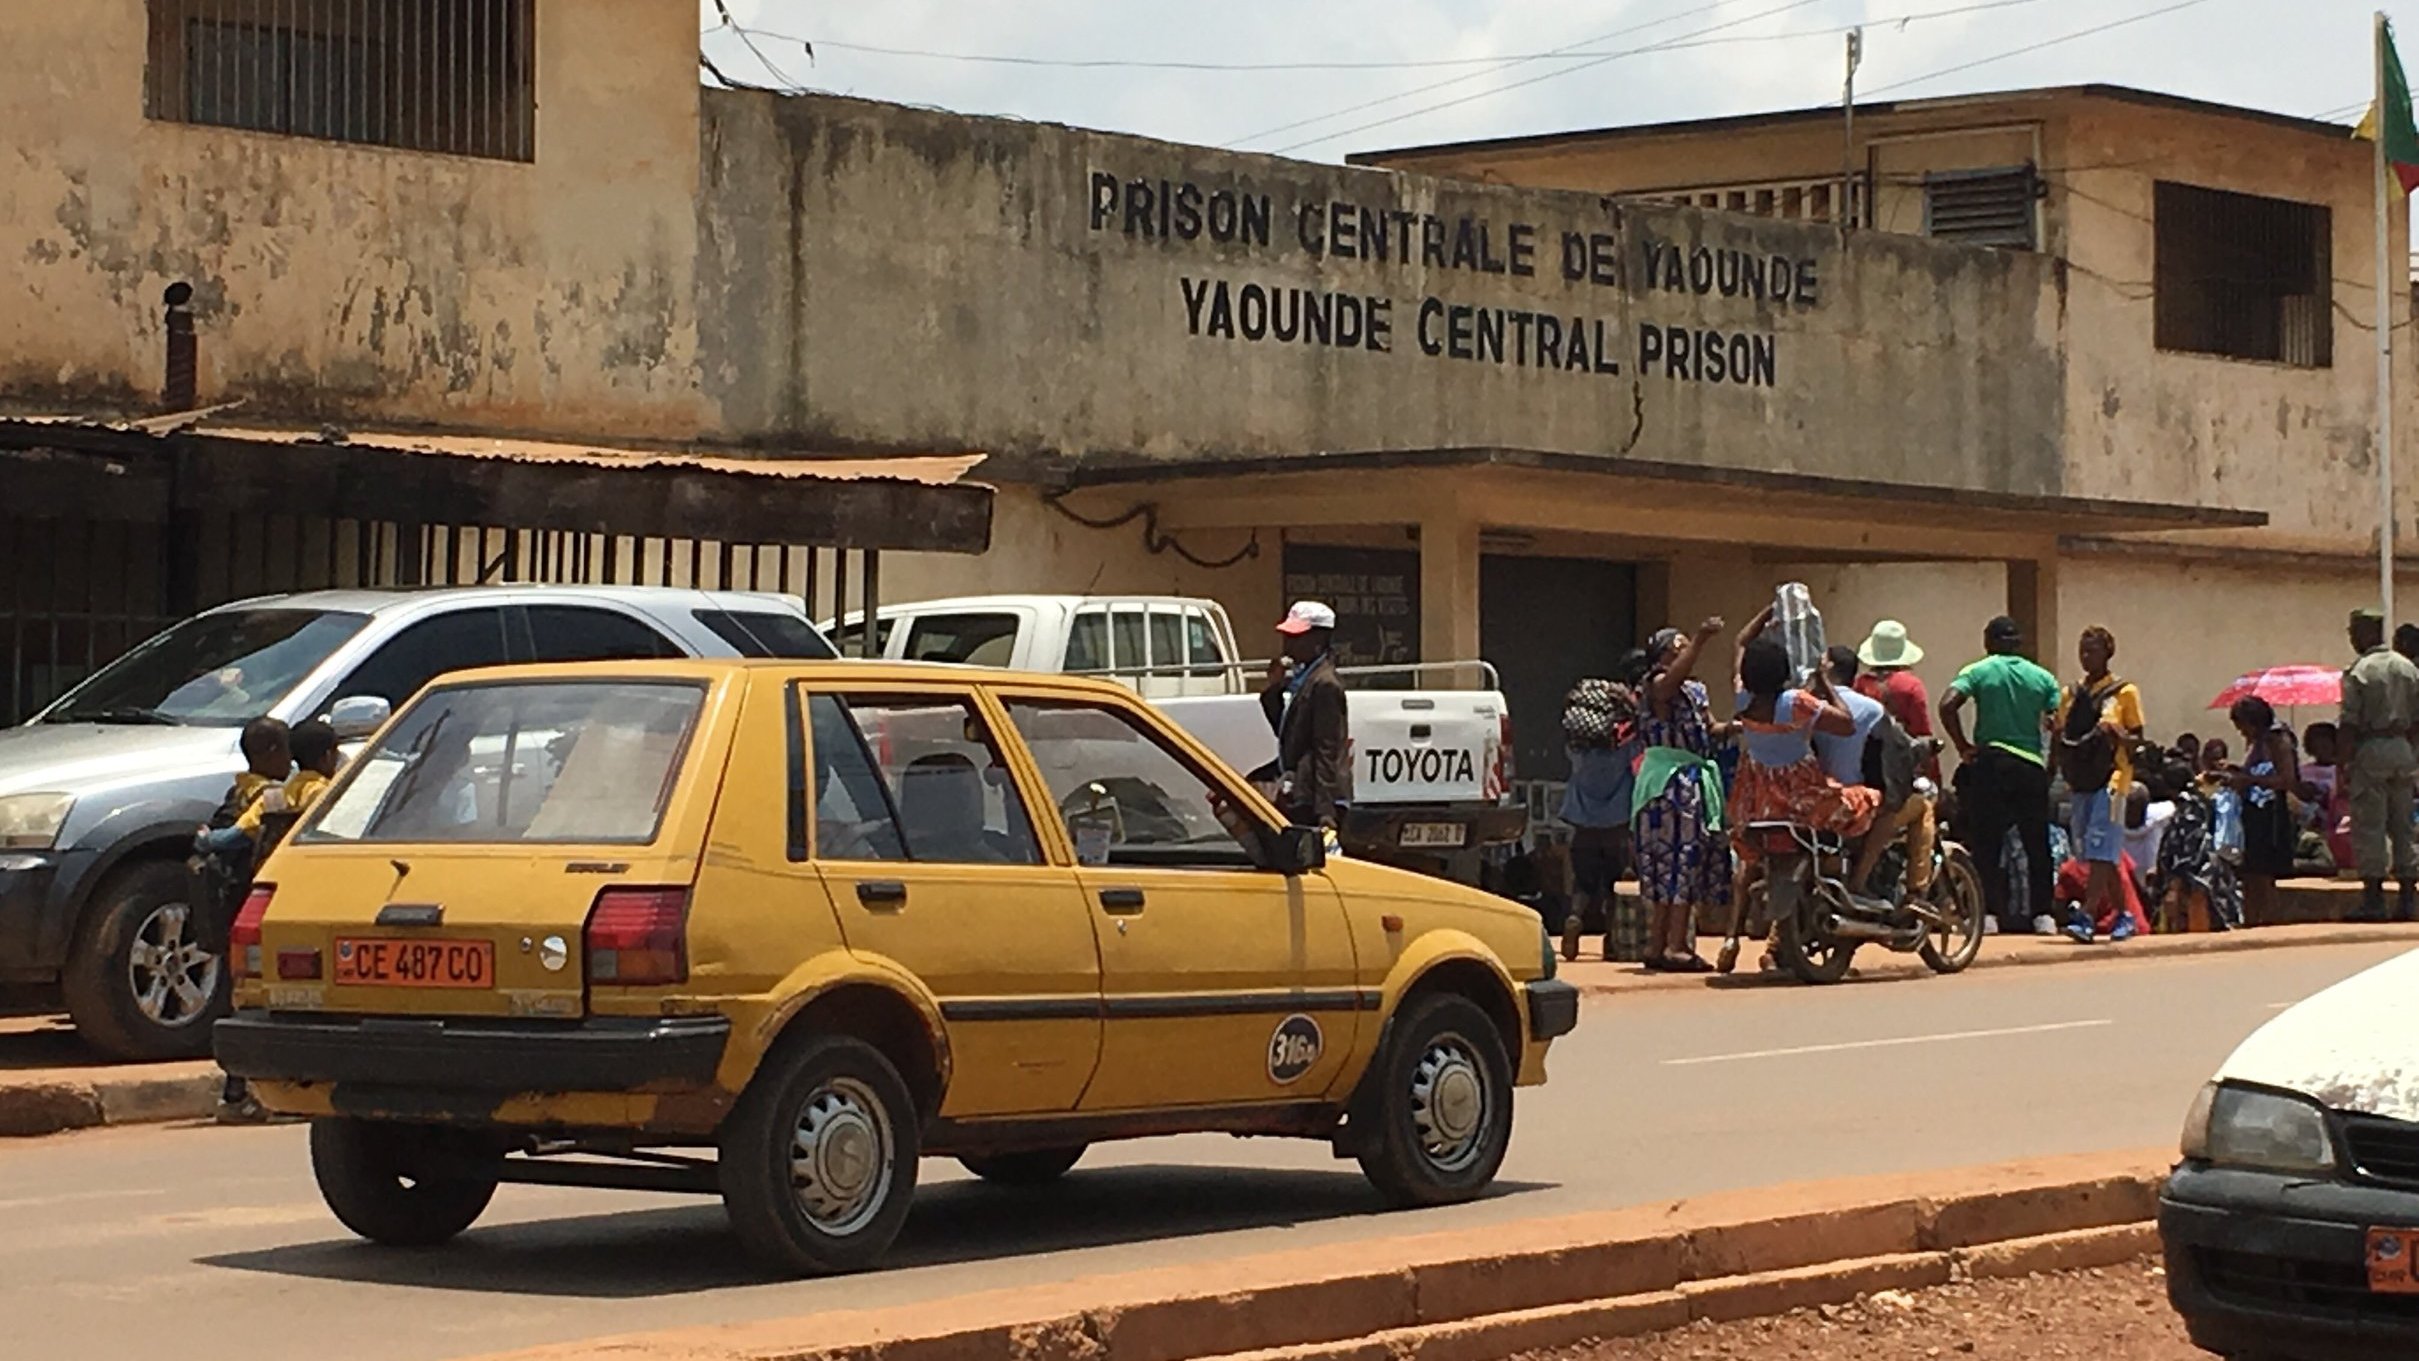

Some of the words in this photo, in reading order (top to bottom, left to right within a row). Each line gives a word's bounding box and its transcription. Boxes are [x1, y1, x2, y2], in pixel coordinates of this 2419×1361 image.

[1090, 171, 1270, 247] PRISON
[1299, 201, 1535, 278] CENTRALE
[1562, 231, 1615, 287] DE
[1643, 241, 1818, 306] YAOUNDE
[1181, 277, 1392, 353] YAOUNDE
[1417, 297, 1619, 376] CENTRAL
[1640, 322, 1776, 387] PRISON
[1365, 748, 1474, 782] TOYOTA
[356, 944, 389, 979] CE
[396, 944, 442, 980] 487
